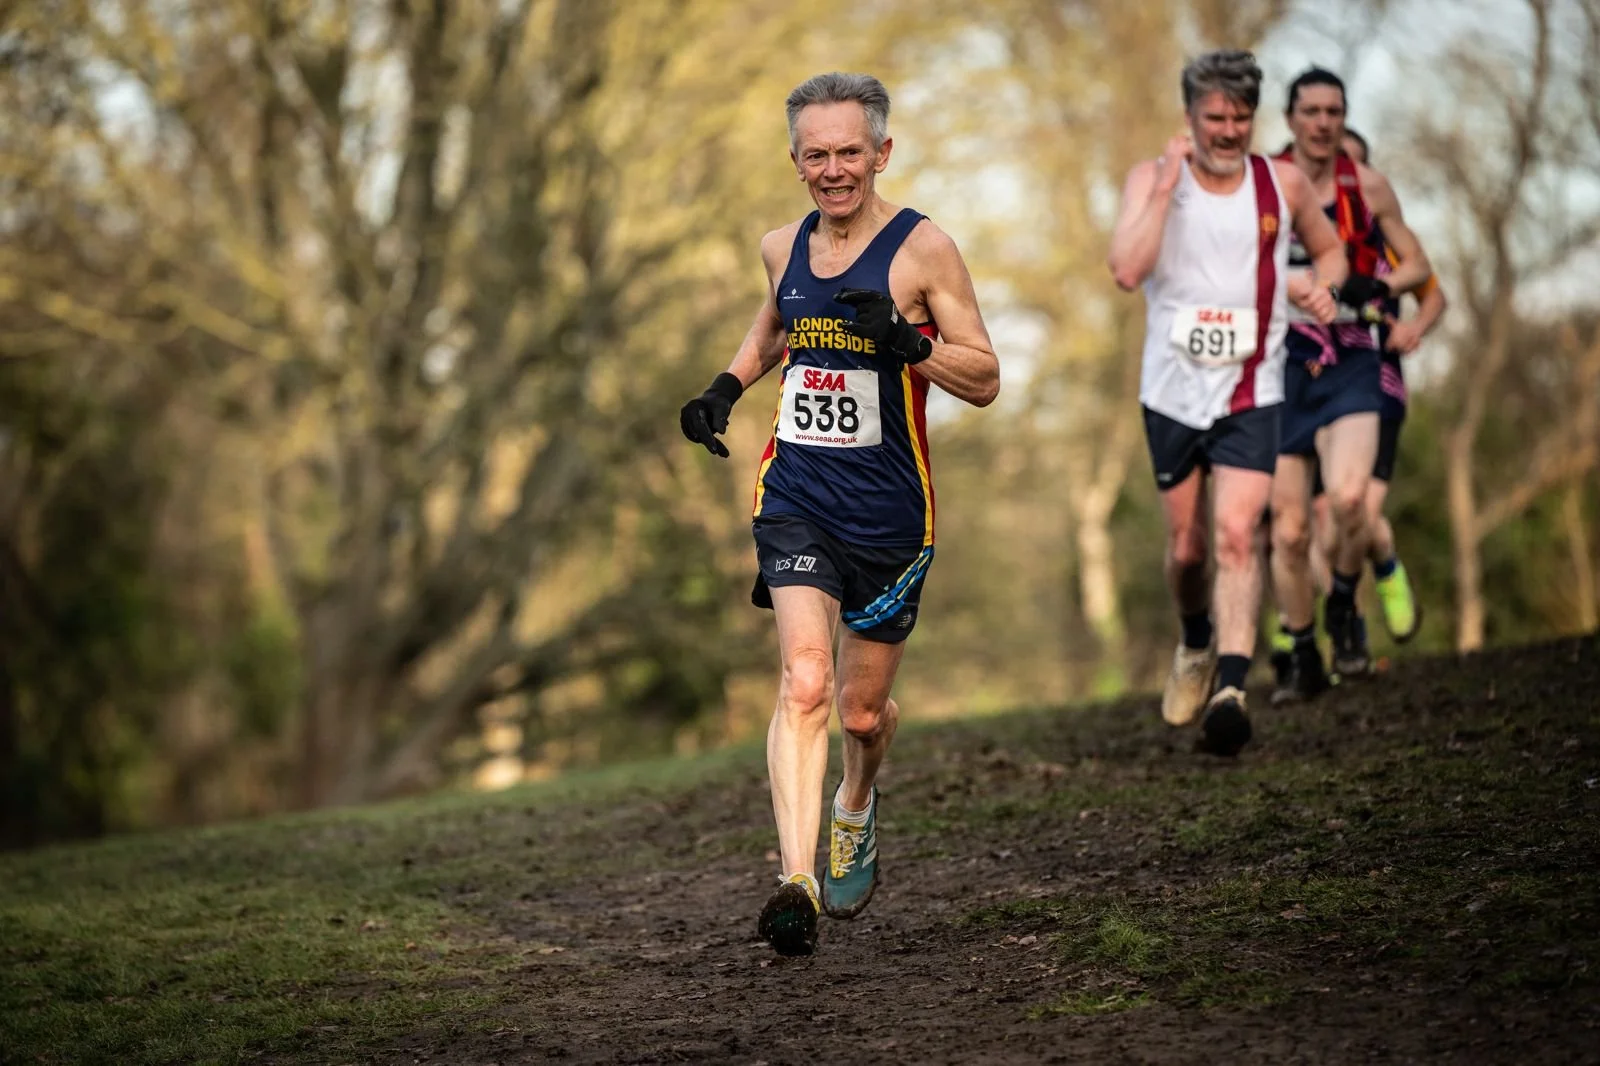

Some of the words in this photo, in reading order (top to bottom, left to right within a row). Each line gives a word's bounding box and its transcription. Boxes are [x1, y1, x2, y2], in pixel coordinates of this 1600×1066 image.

[793, 317, 853, 334] LONDO
[1189, 328, 1235, 356] 691
[803, 368, 846, 392] SEAA
[794, 392, 859, 434] 538
[795, 433, 858, 444] www.seaa.org.uk
